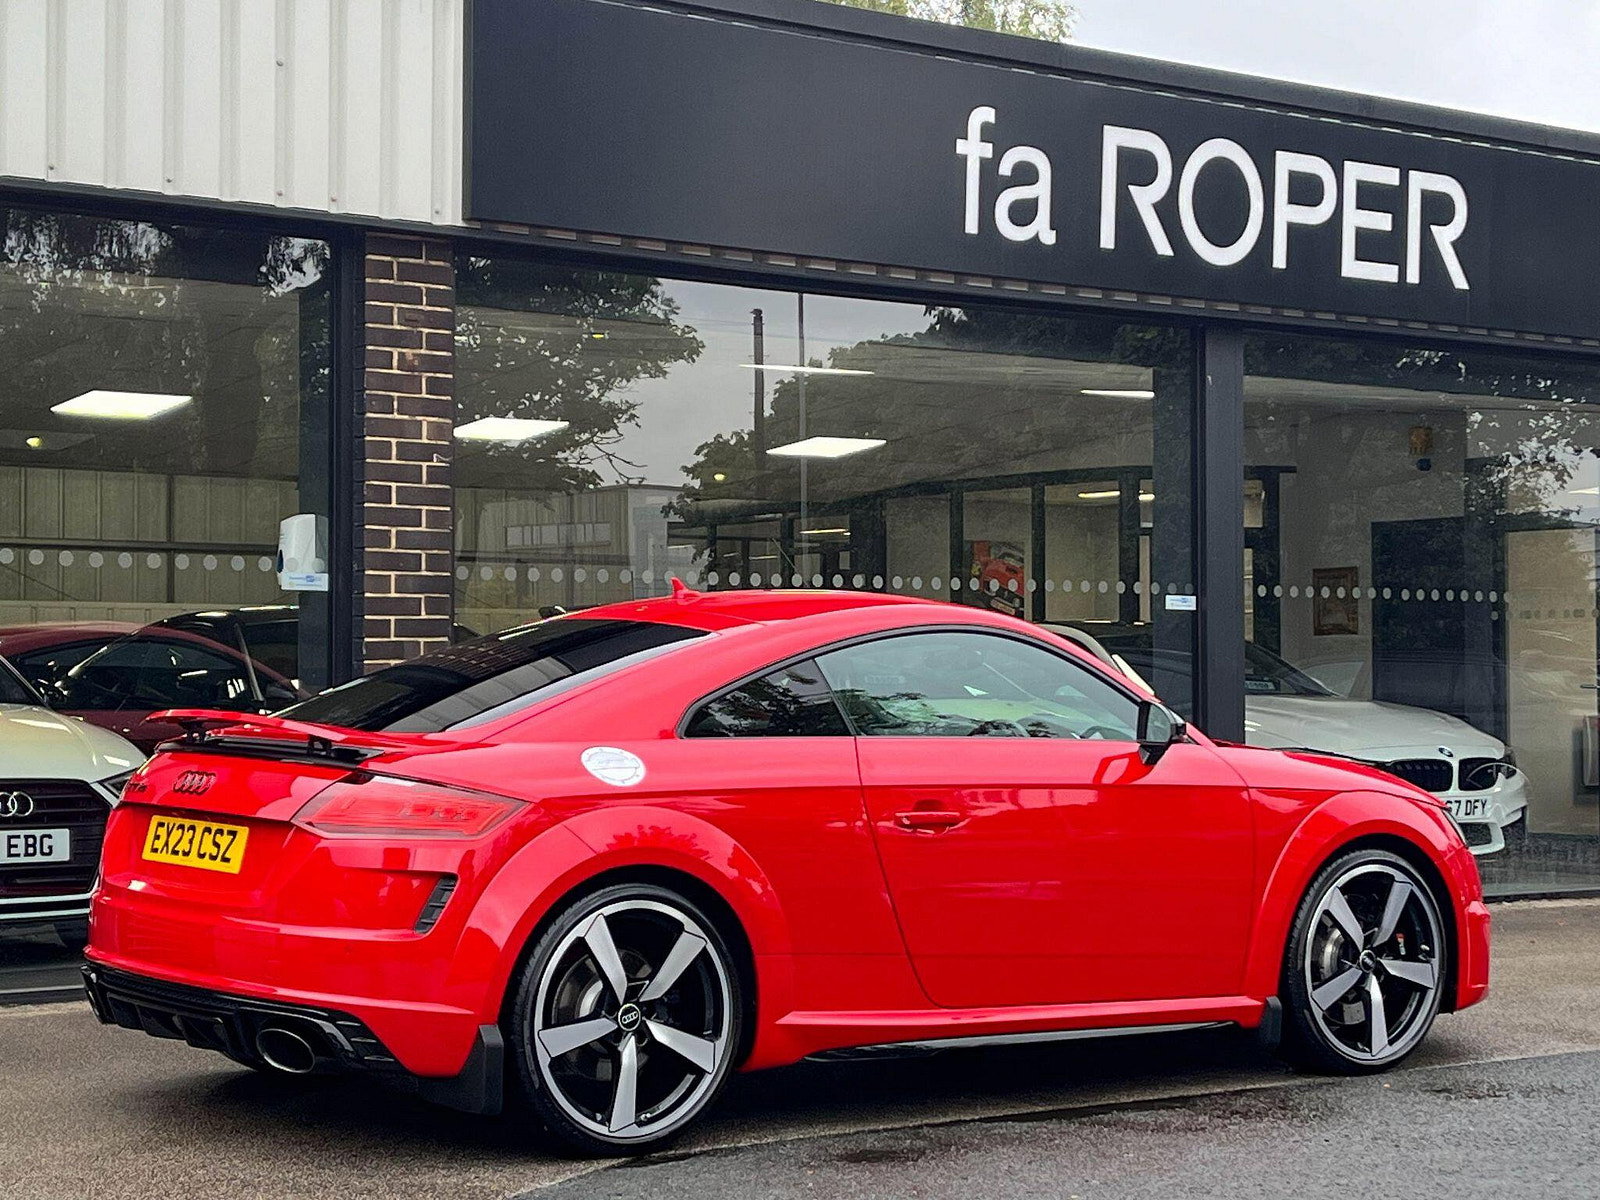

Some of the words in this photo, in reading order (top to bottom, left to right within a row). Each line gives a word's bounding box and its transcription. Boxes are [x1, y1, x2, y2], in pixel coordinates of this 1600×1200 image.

[955, 106, 1057, 246] fa
[1099, 124, 1470, 290] ROPER
[1465, 799, 1487, 816] DFY
[6, 833, 54, 858] EBG
[150, 821, 197, 857] EX23
[197, 826, 238, 863] CSZ
